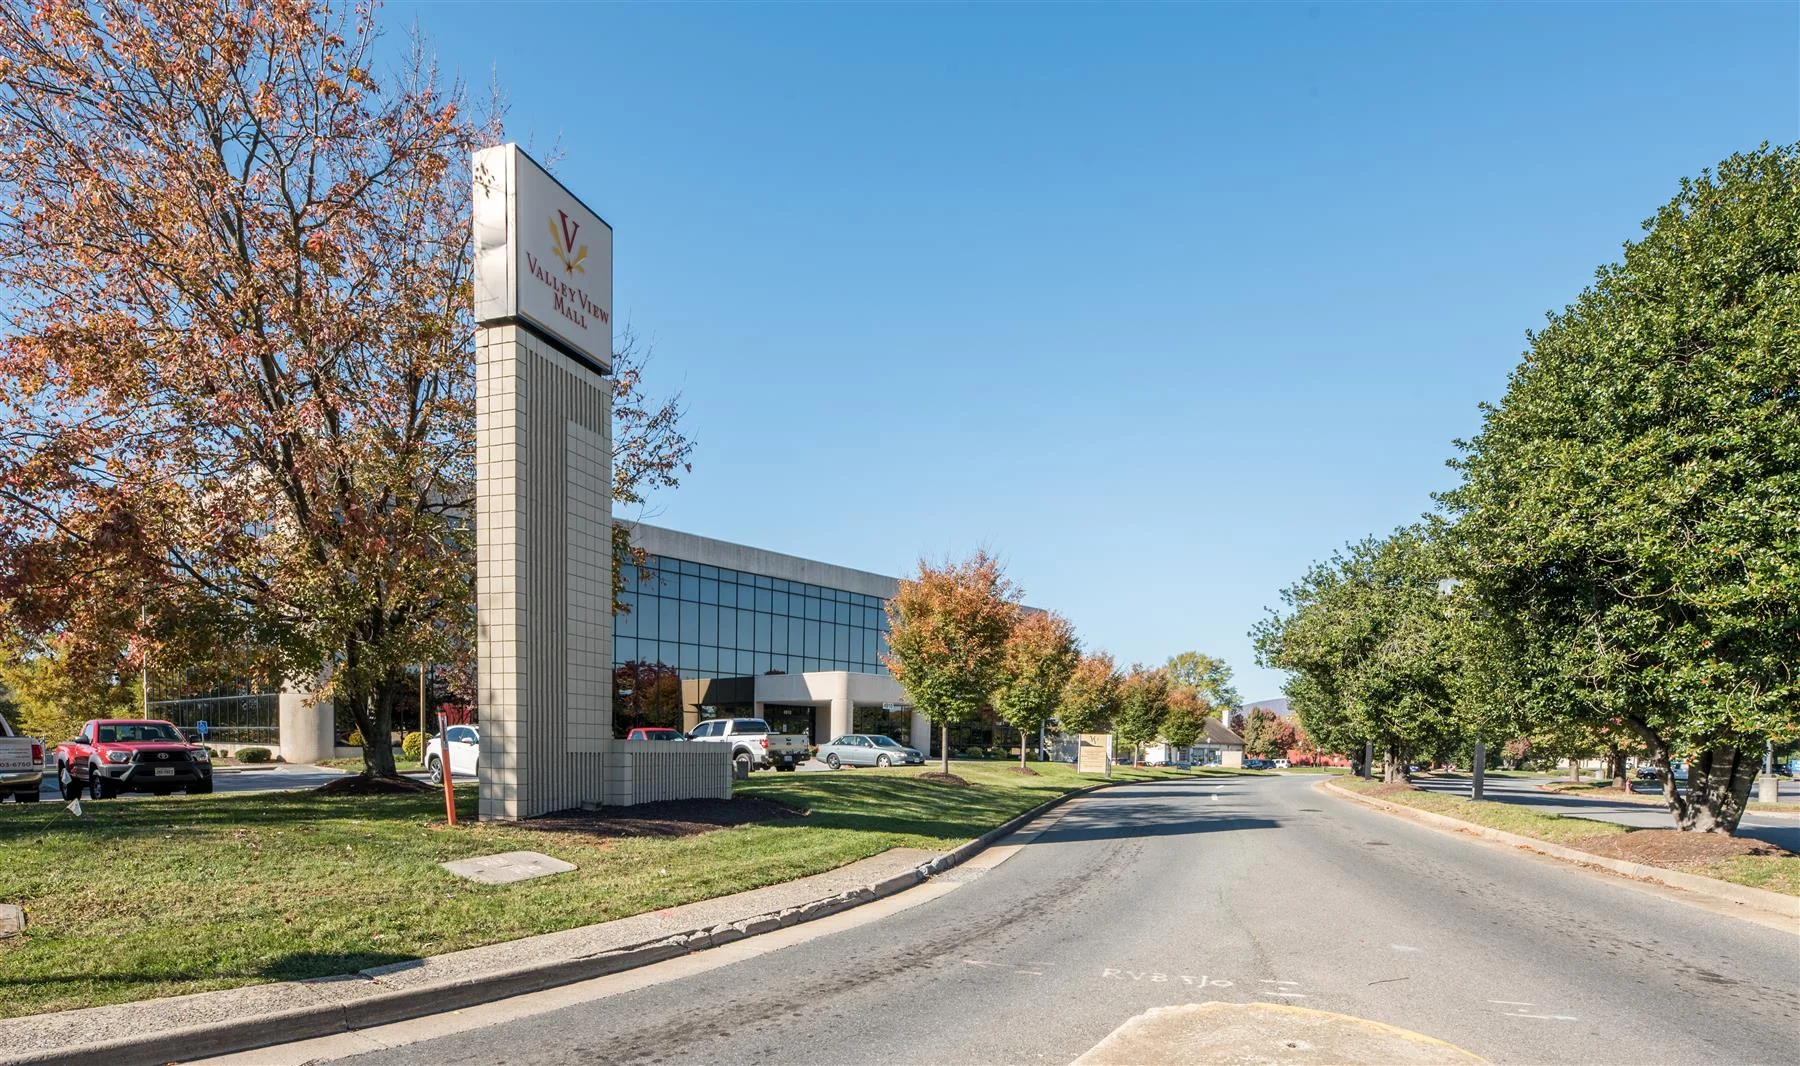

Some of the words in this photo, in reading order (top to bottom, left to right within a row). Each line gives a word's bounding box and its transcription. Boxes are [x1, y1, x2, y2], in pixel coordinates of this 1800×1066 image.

[558, 209, 580, 253] V
[526, 251, 577, 303] VALLEY
[578, 289, 609, 325] VIEW
[553, 292, 588, 330] MALL
